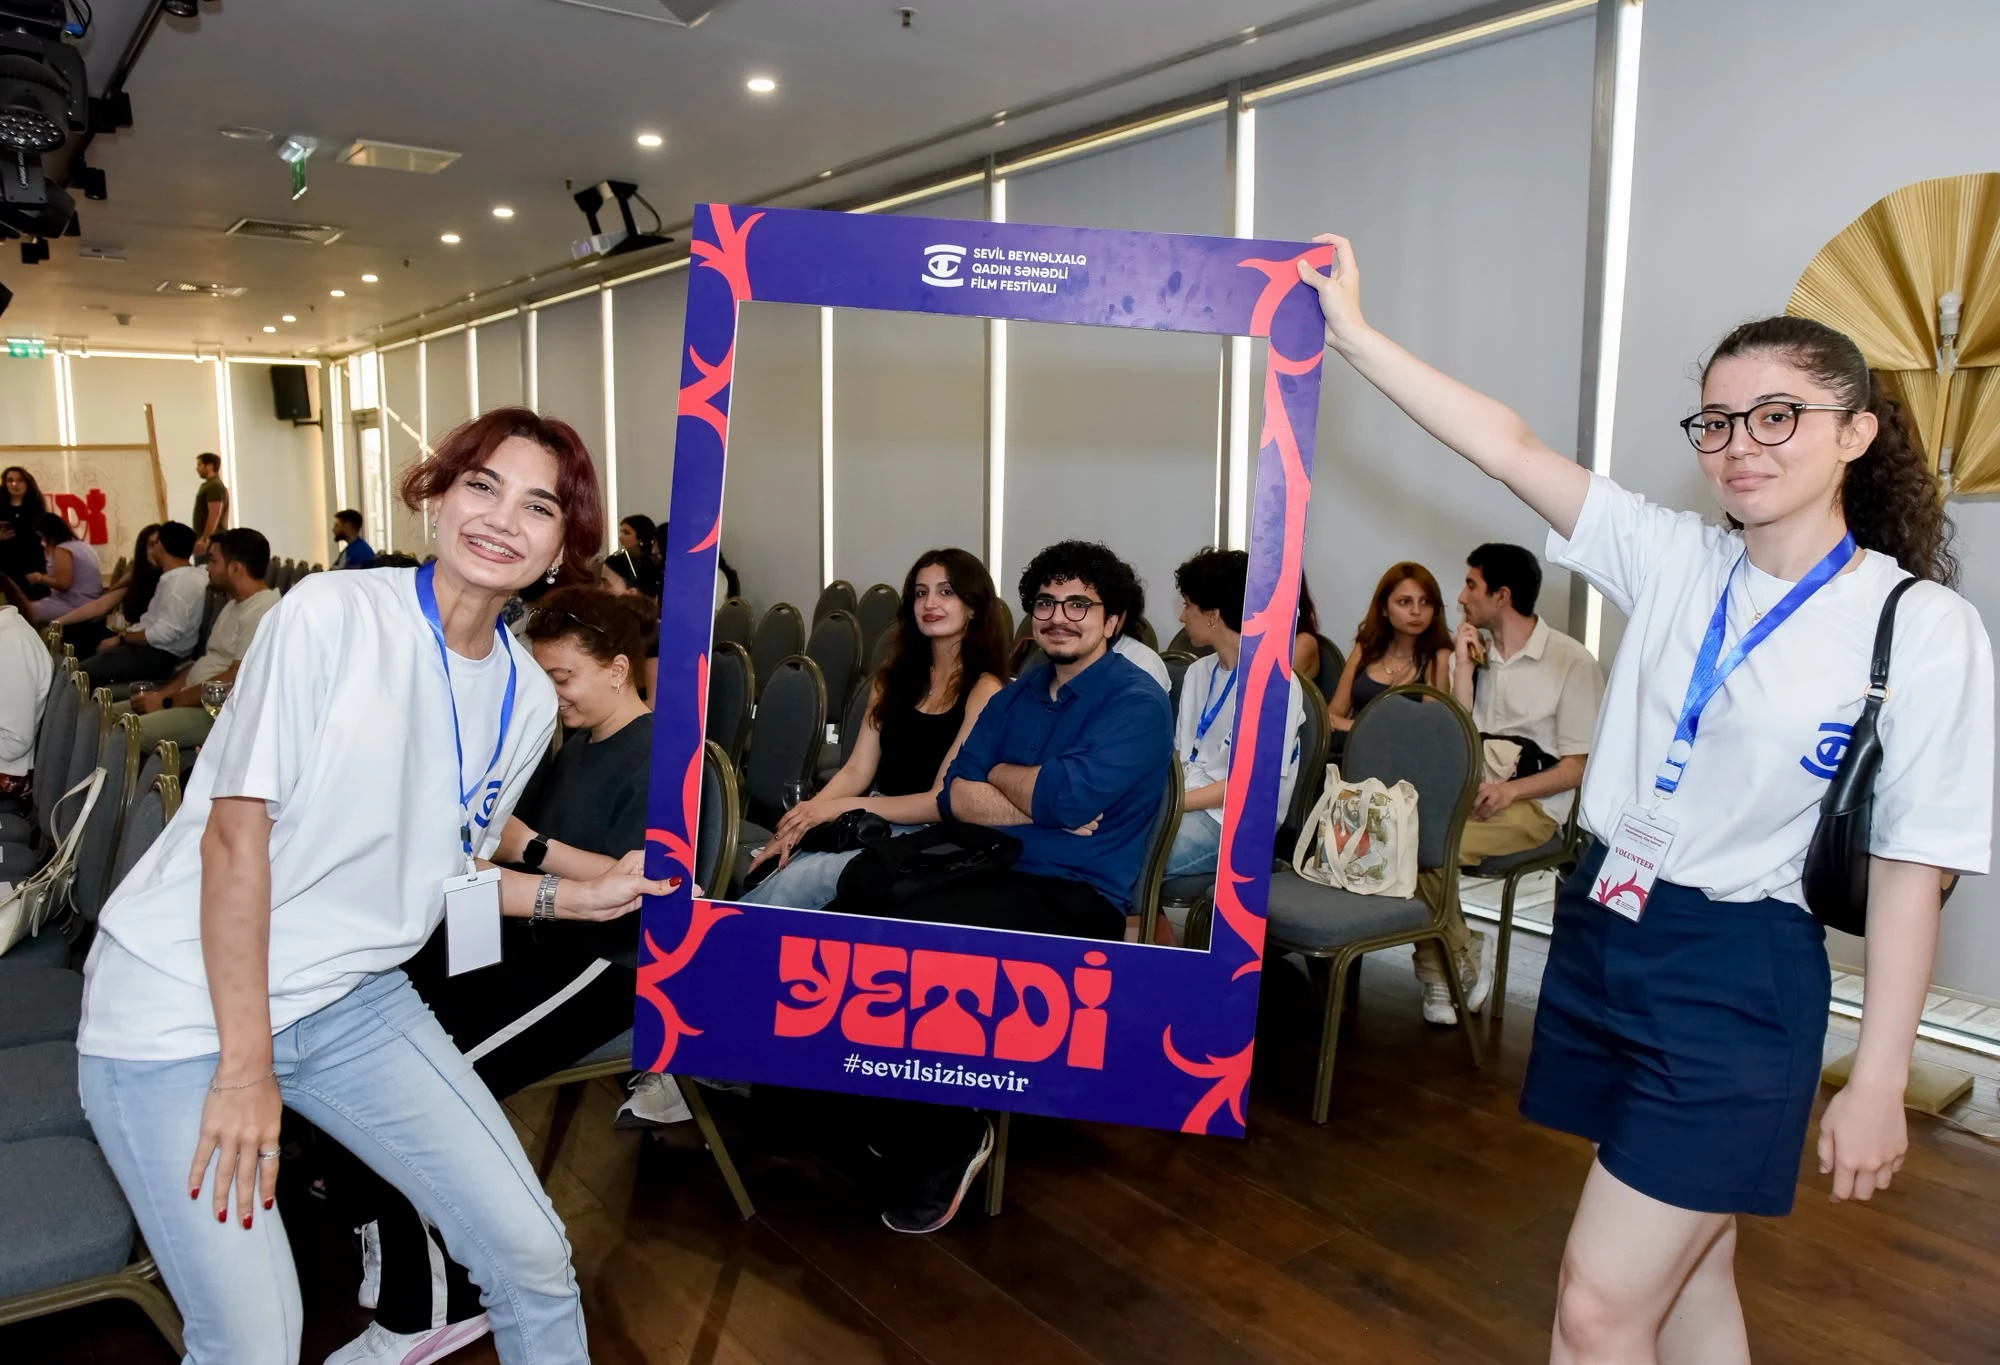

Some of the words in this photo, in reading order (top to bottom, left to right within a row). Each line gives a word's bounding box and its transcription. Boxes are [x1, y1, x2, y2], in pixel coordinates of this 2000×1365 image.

[973, 247, 1005, 260] SEVİL
[1008, 250, 1087, 266] BEYNƏLXALQ
[971, 263, 1011, 276] QADIN
[1014, 265, 1069, 279] SƏNƏDLİ
[970, 276, 997, 290] FİLM
[1000, 279, 1057, 294] FESTİVALI
[1615, 846, 1655, 871] VOLUNTEER
[843, 1053, 1029, 1092] #sevilsizisevir
